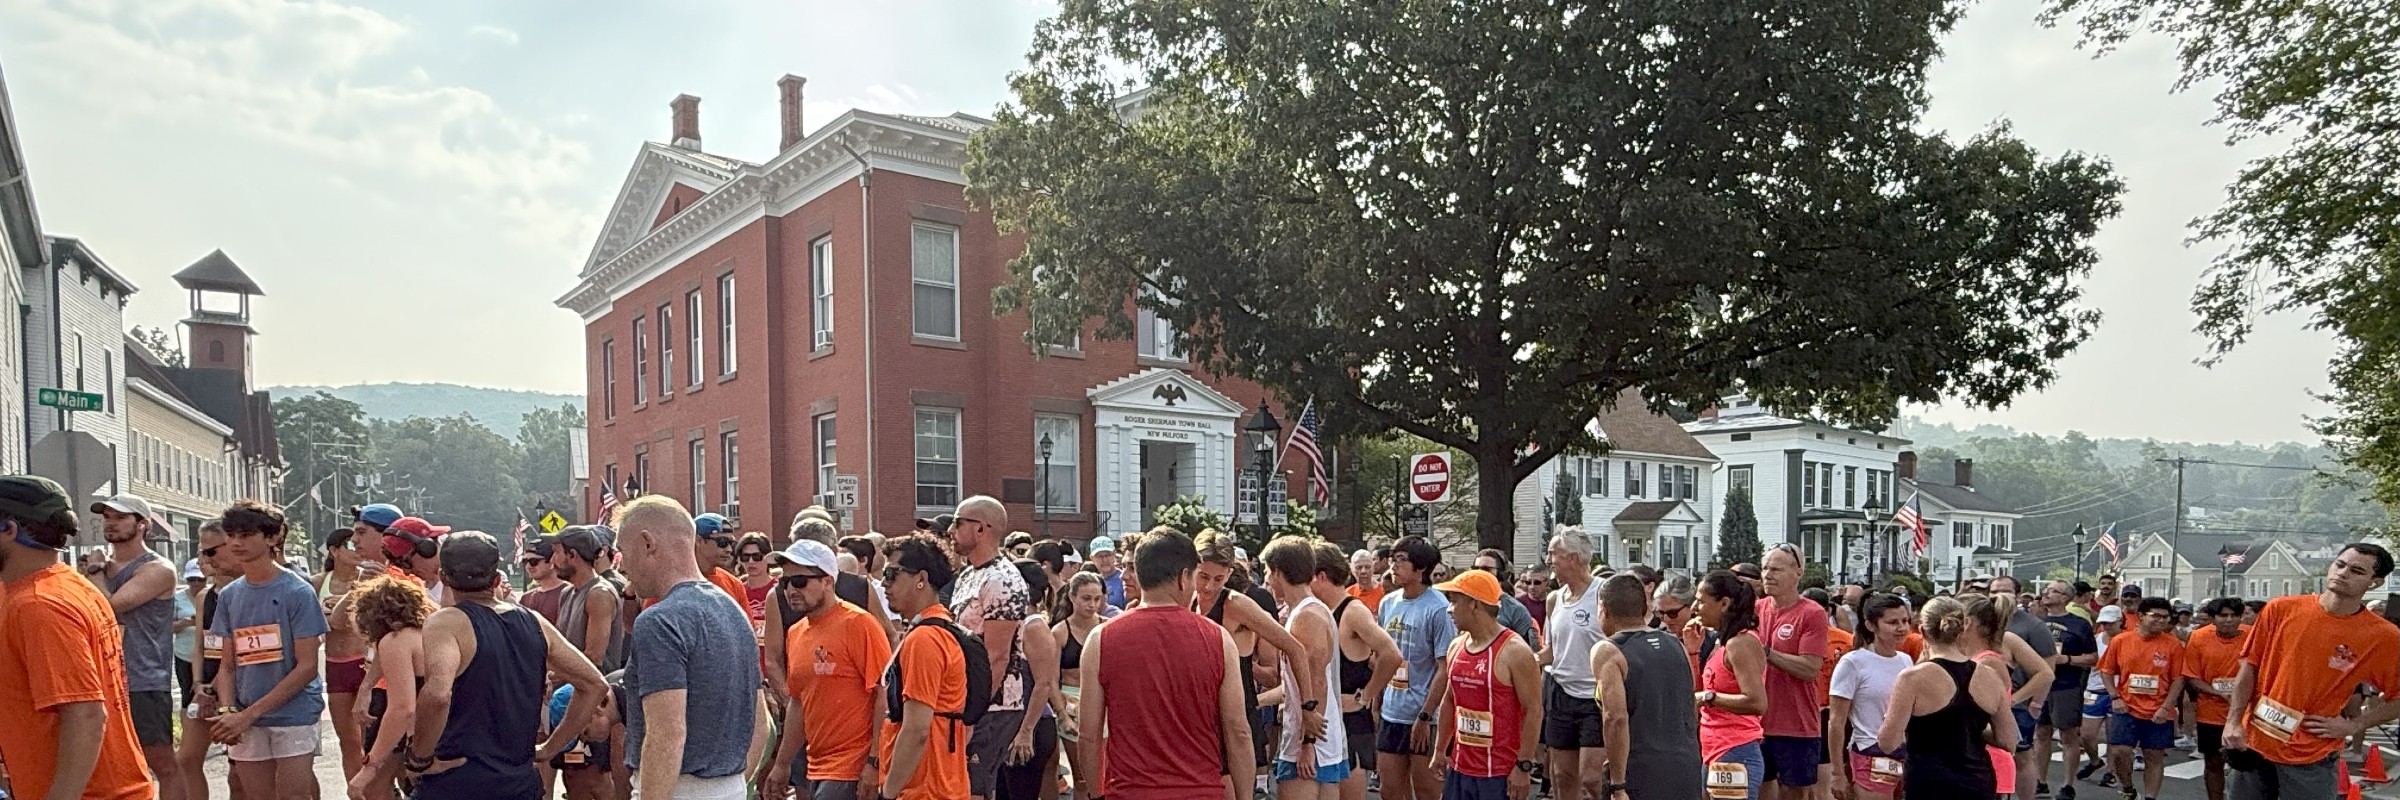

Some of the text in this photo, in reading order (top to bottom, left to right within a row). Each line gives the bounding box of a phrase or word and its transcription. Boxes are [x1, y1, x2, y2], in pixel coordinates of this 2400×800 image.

[57, 391, 88, 408] Main
[1124, 415, 1212, 430] ROGER SHERMAN TOWN HALL
[1147, 430, 1189, 440] NEW MILFORD
[1418, 463, 1442, 473] DO NOT
[1420, 483, 1441, 494] ENTER
[840, 493, 855, 505] 15
[247, 635, 261, 649] 21
[2264, 707, 2287, 725] 1004
[1461, 717, 1481, 732] 1193
[1715, 772, 1733, 784] 169
